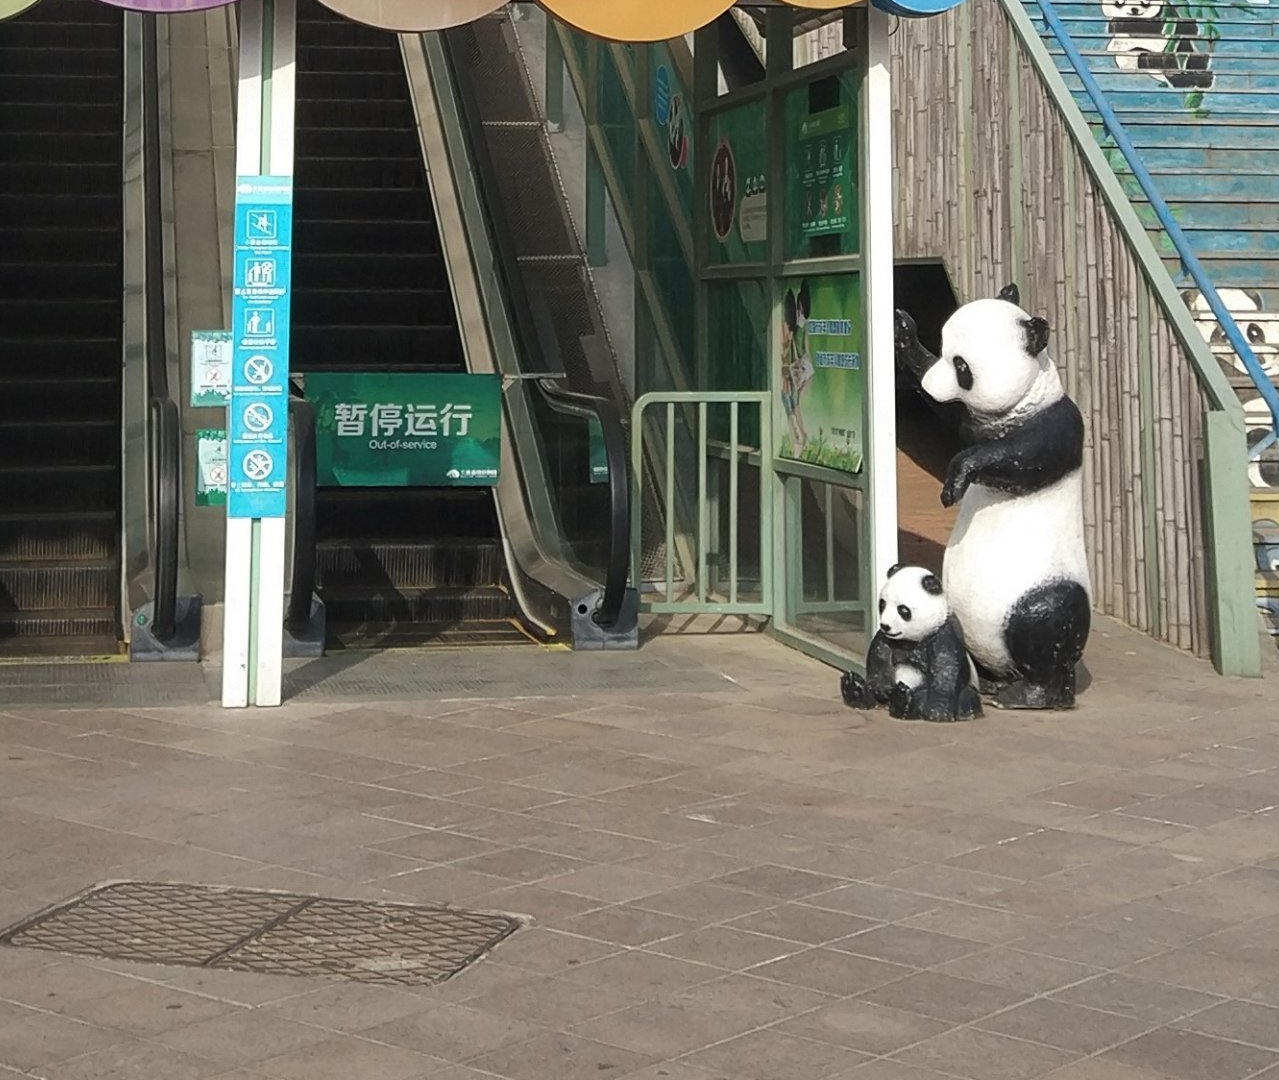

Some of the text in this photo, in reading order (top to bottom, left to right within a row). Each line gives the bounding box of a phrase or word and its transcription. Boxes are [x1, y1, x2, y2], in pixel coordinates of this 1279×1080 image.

[334, 402, 473, 437] 暂停运行
[368, 439, 438, 451] Out-of-service
